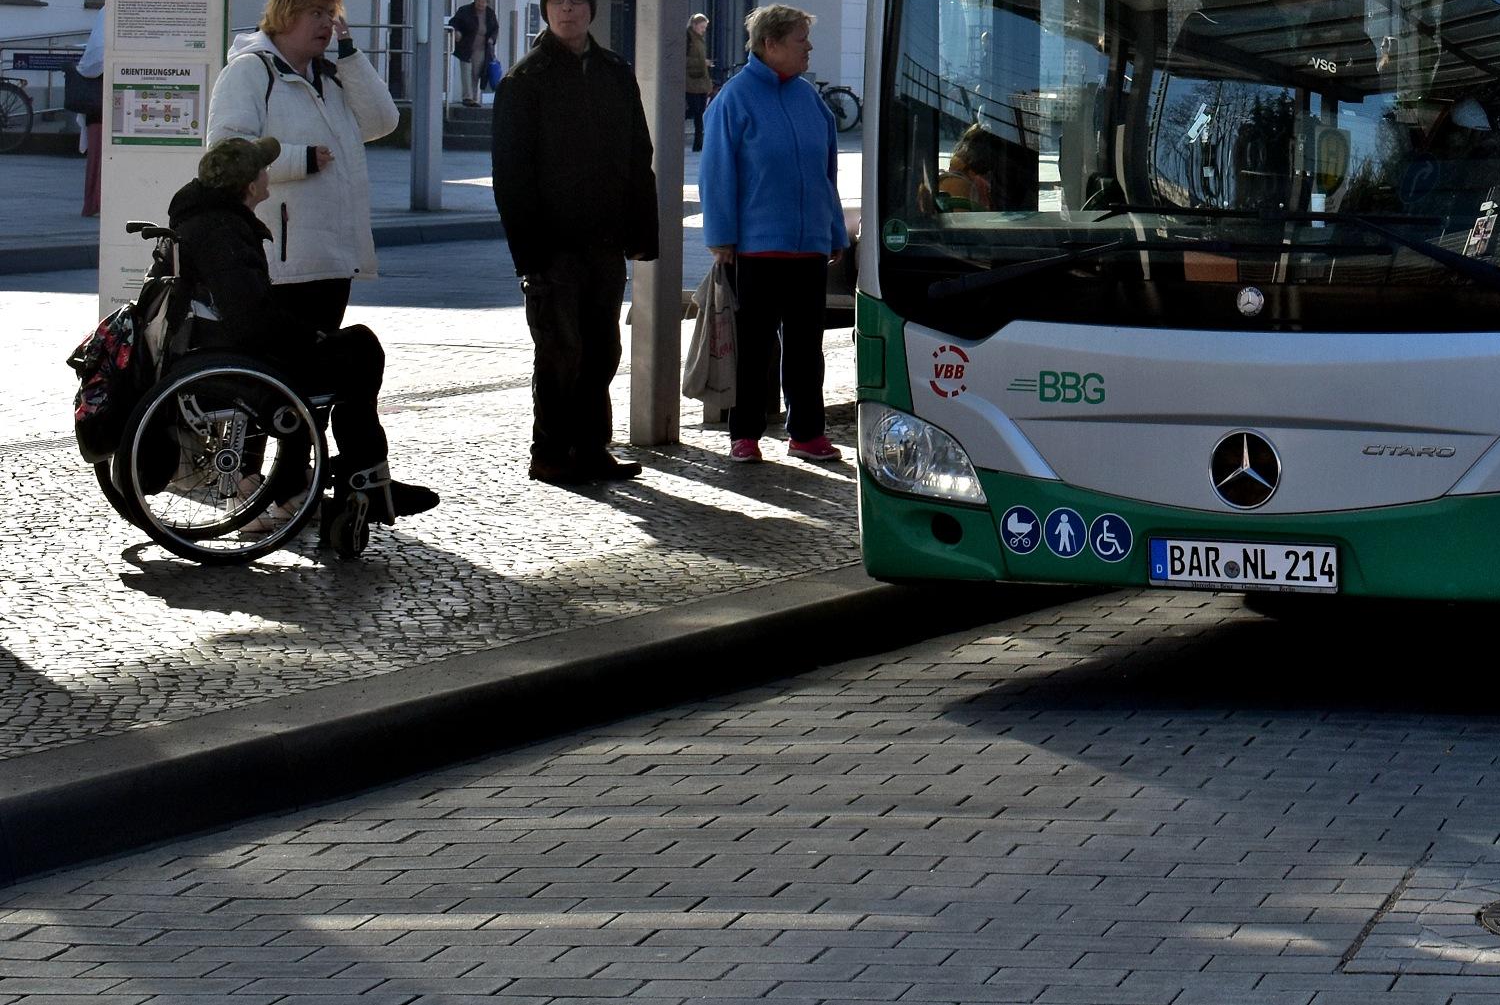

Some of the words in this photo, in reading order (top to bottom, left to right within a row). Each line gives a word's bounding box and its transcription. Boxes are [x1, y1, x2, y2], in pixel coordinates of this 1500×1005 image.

[120, 68, 191, 77] ORIENTIERUNGSPLAN
[933, 363, 965, 380] VBB
[1039, 370, 1106, 404] BBG
[1361, 445, 1457, 458] CITARO
[1169, 545, 1221, 578] BAR
[1242, 548, 1277, 580] NL
[1284, 550, 1335, 583] 214
